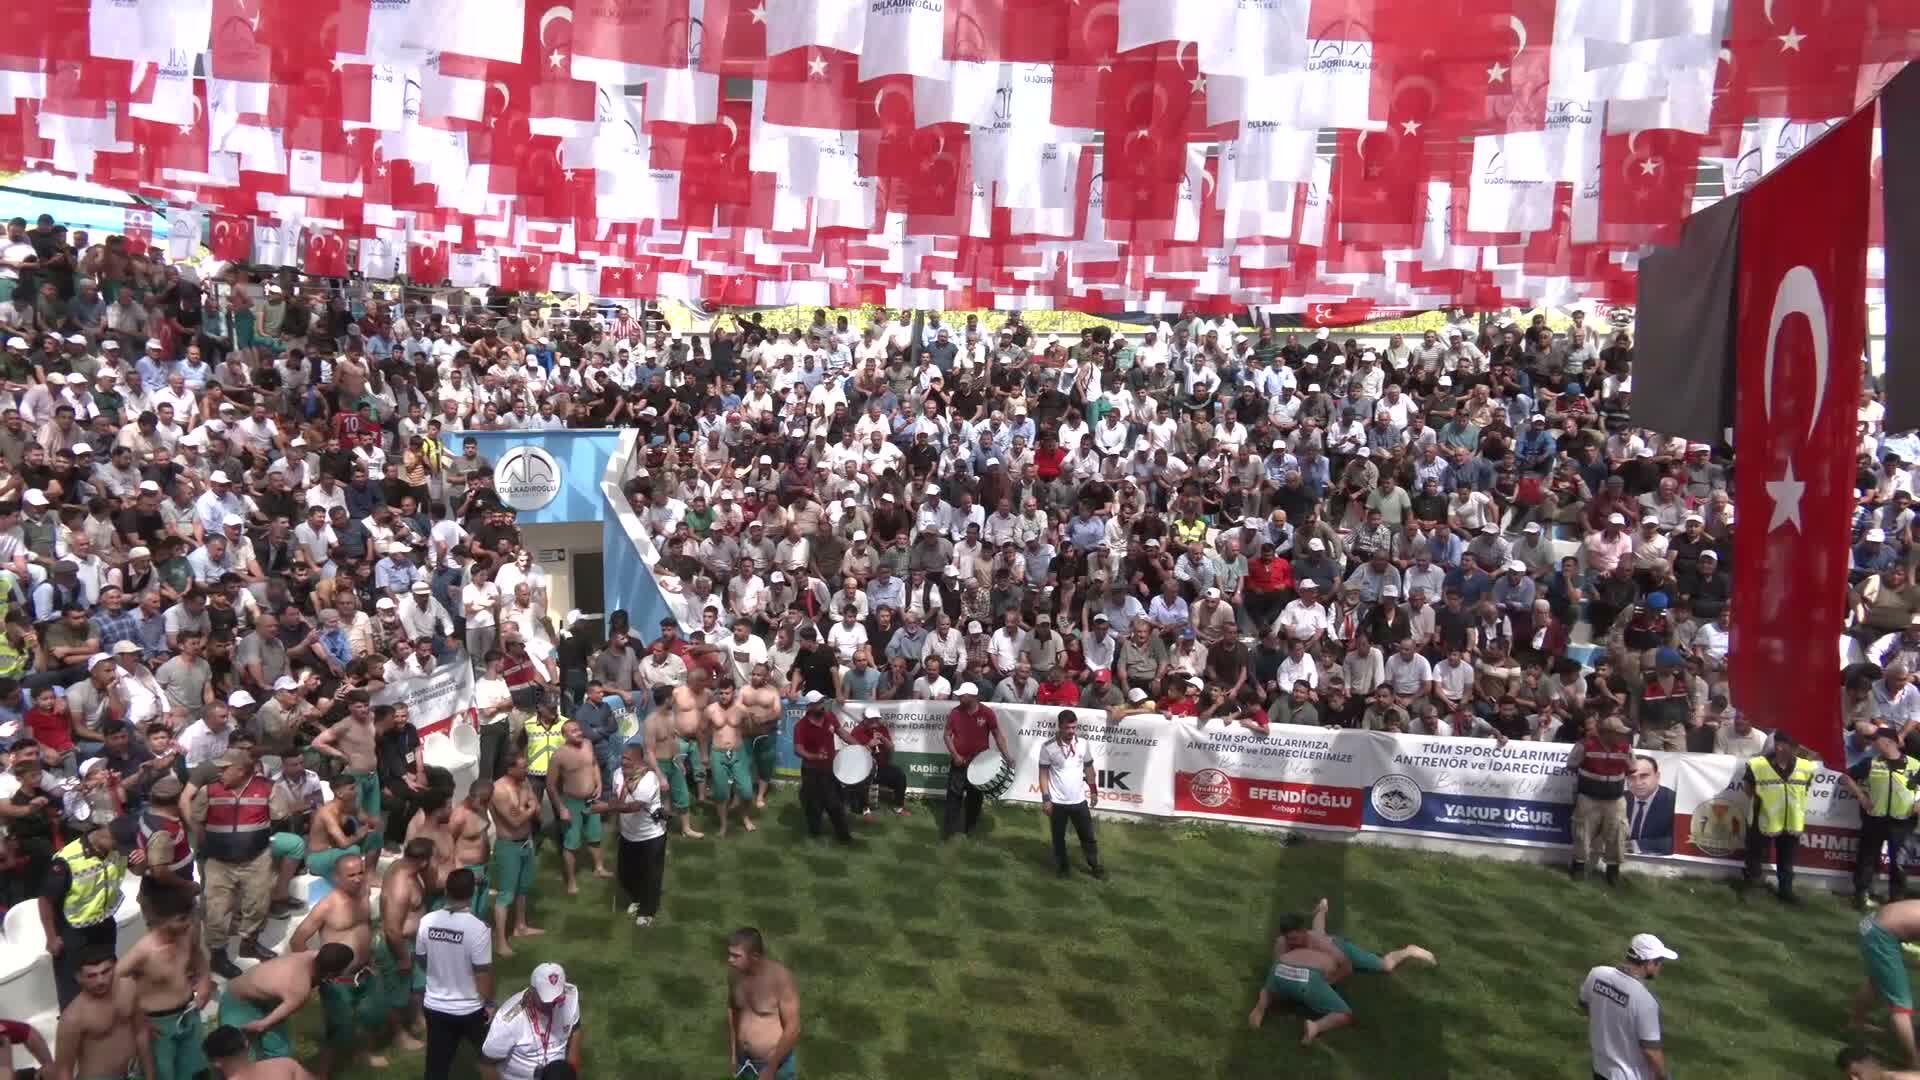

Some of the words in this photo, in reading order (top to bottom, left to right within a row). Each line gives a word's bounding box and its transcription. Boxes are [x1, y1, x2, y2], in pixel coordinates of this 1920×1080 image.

[343, 416, 359, 433] 10
[1077, 724, 1137, 736] RCULARIMIZA
[1208, 732, 1233, 743] TÜM
[1187, 741, 1245, 754] ANTRENÖR
[1246, 748, 1258, 756] ve
[1422, 743, 1451, 756] TÜM
[1454, 745, 1569, 763] SPORCULARIMIZ
[1393, 754, 1468, 770] ANTRENÖR
[1471, 762, 1485, 770] ve
[1248, 786, 1353, 809] EFENDİOĞLU
[1444, 802, 1502, 822] YAKUP
[1503, 805, 1554, 825] UĞUR
